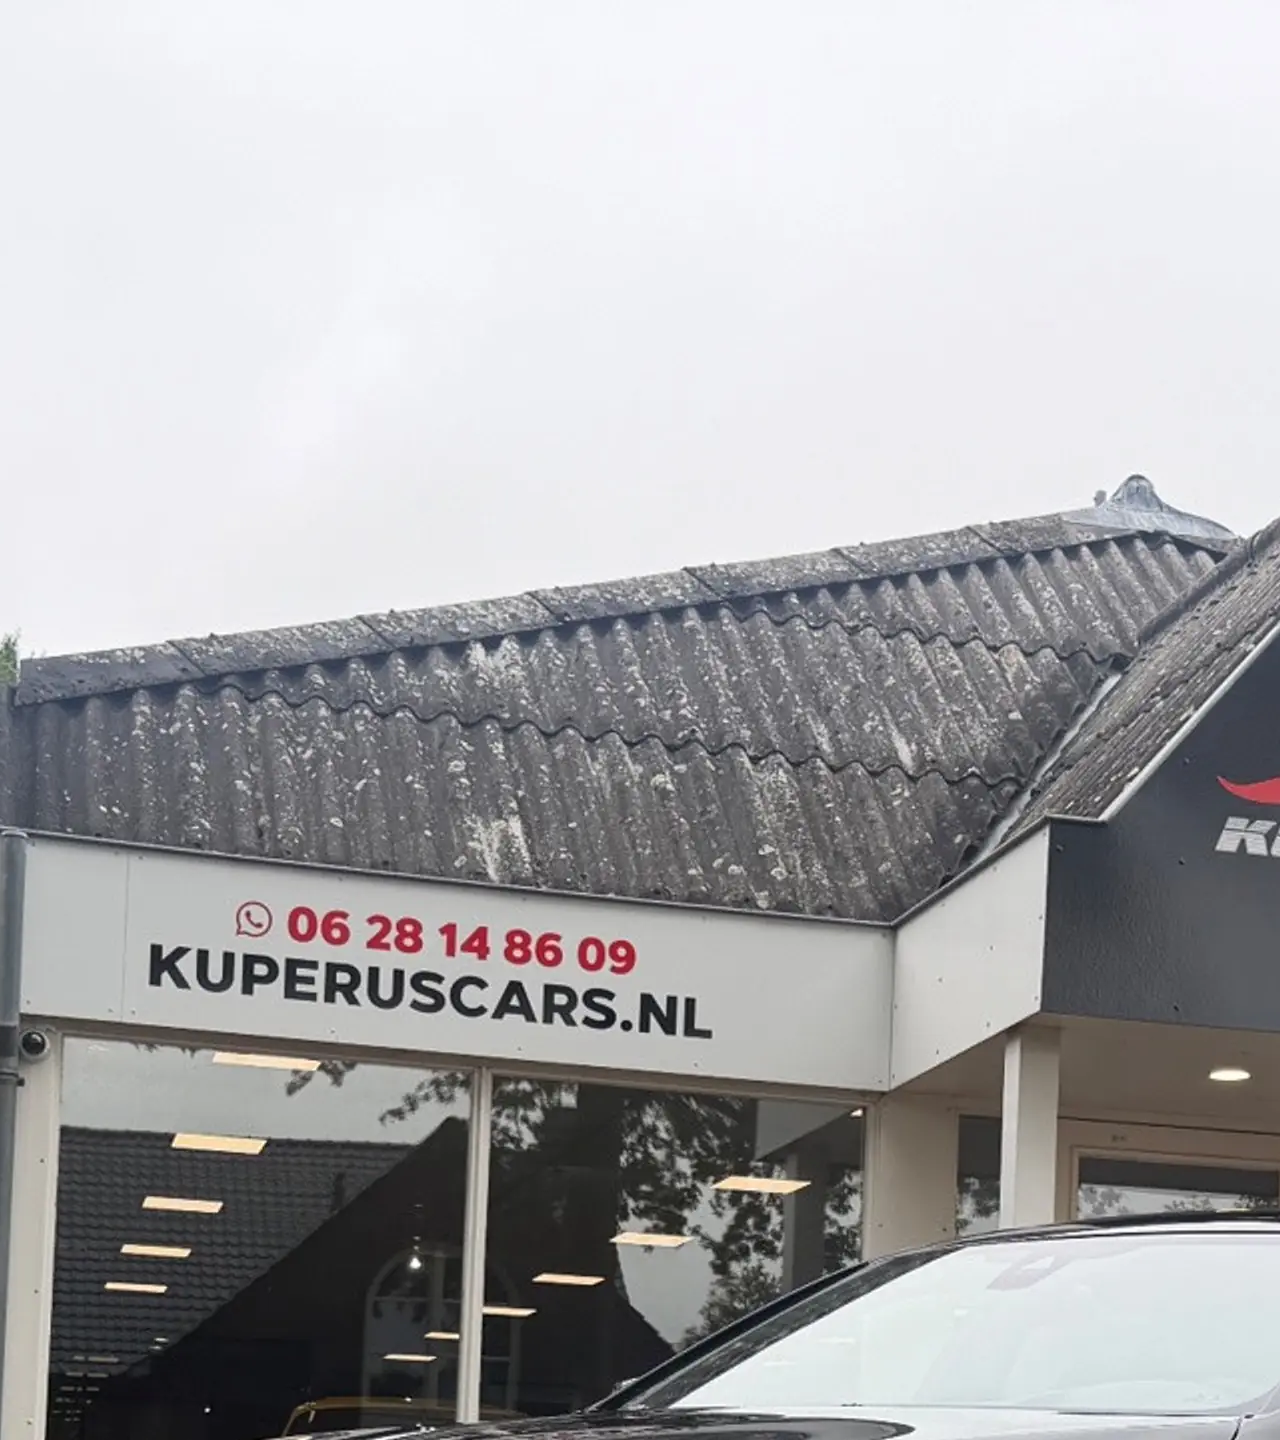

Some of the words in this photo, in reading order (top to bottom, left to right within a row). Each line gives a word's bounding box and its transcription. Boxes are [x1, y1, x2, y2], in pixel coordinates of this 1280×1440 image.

[287, 905, 351, 946] 06
[365, 913, 424, 954] 28
[438, 922, 491, 961] 14
[503, 928, 564, 968] 86
[577, 936, 637, 976] 09
[148, 942, 713, 1040] KUPERUSCARS.NL
